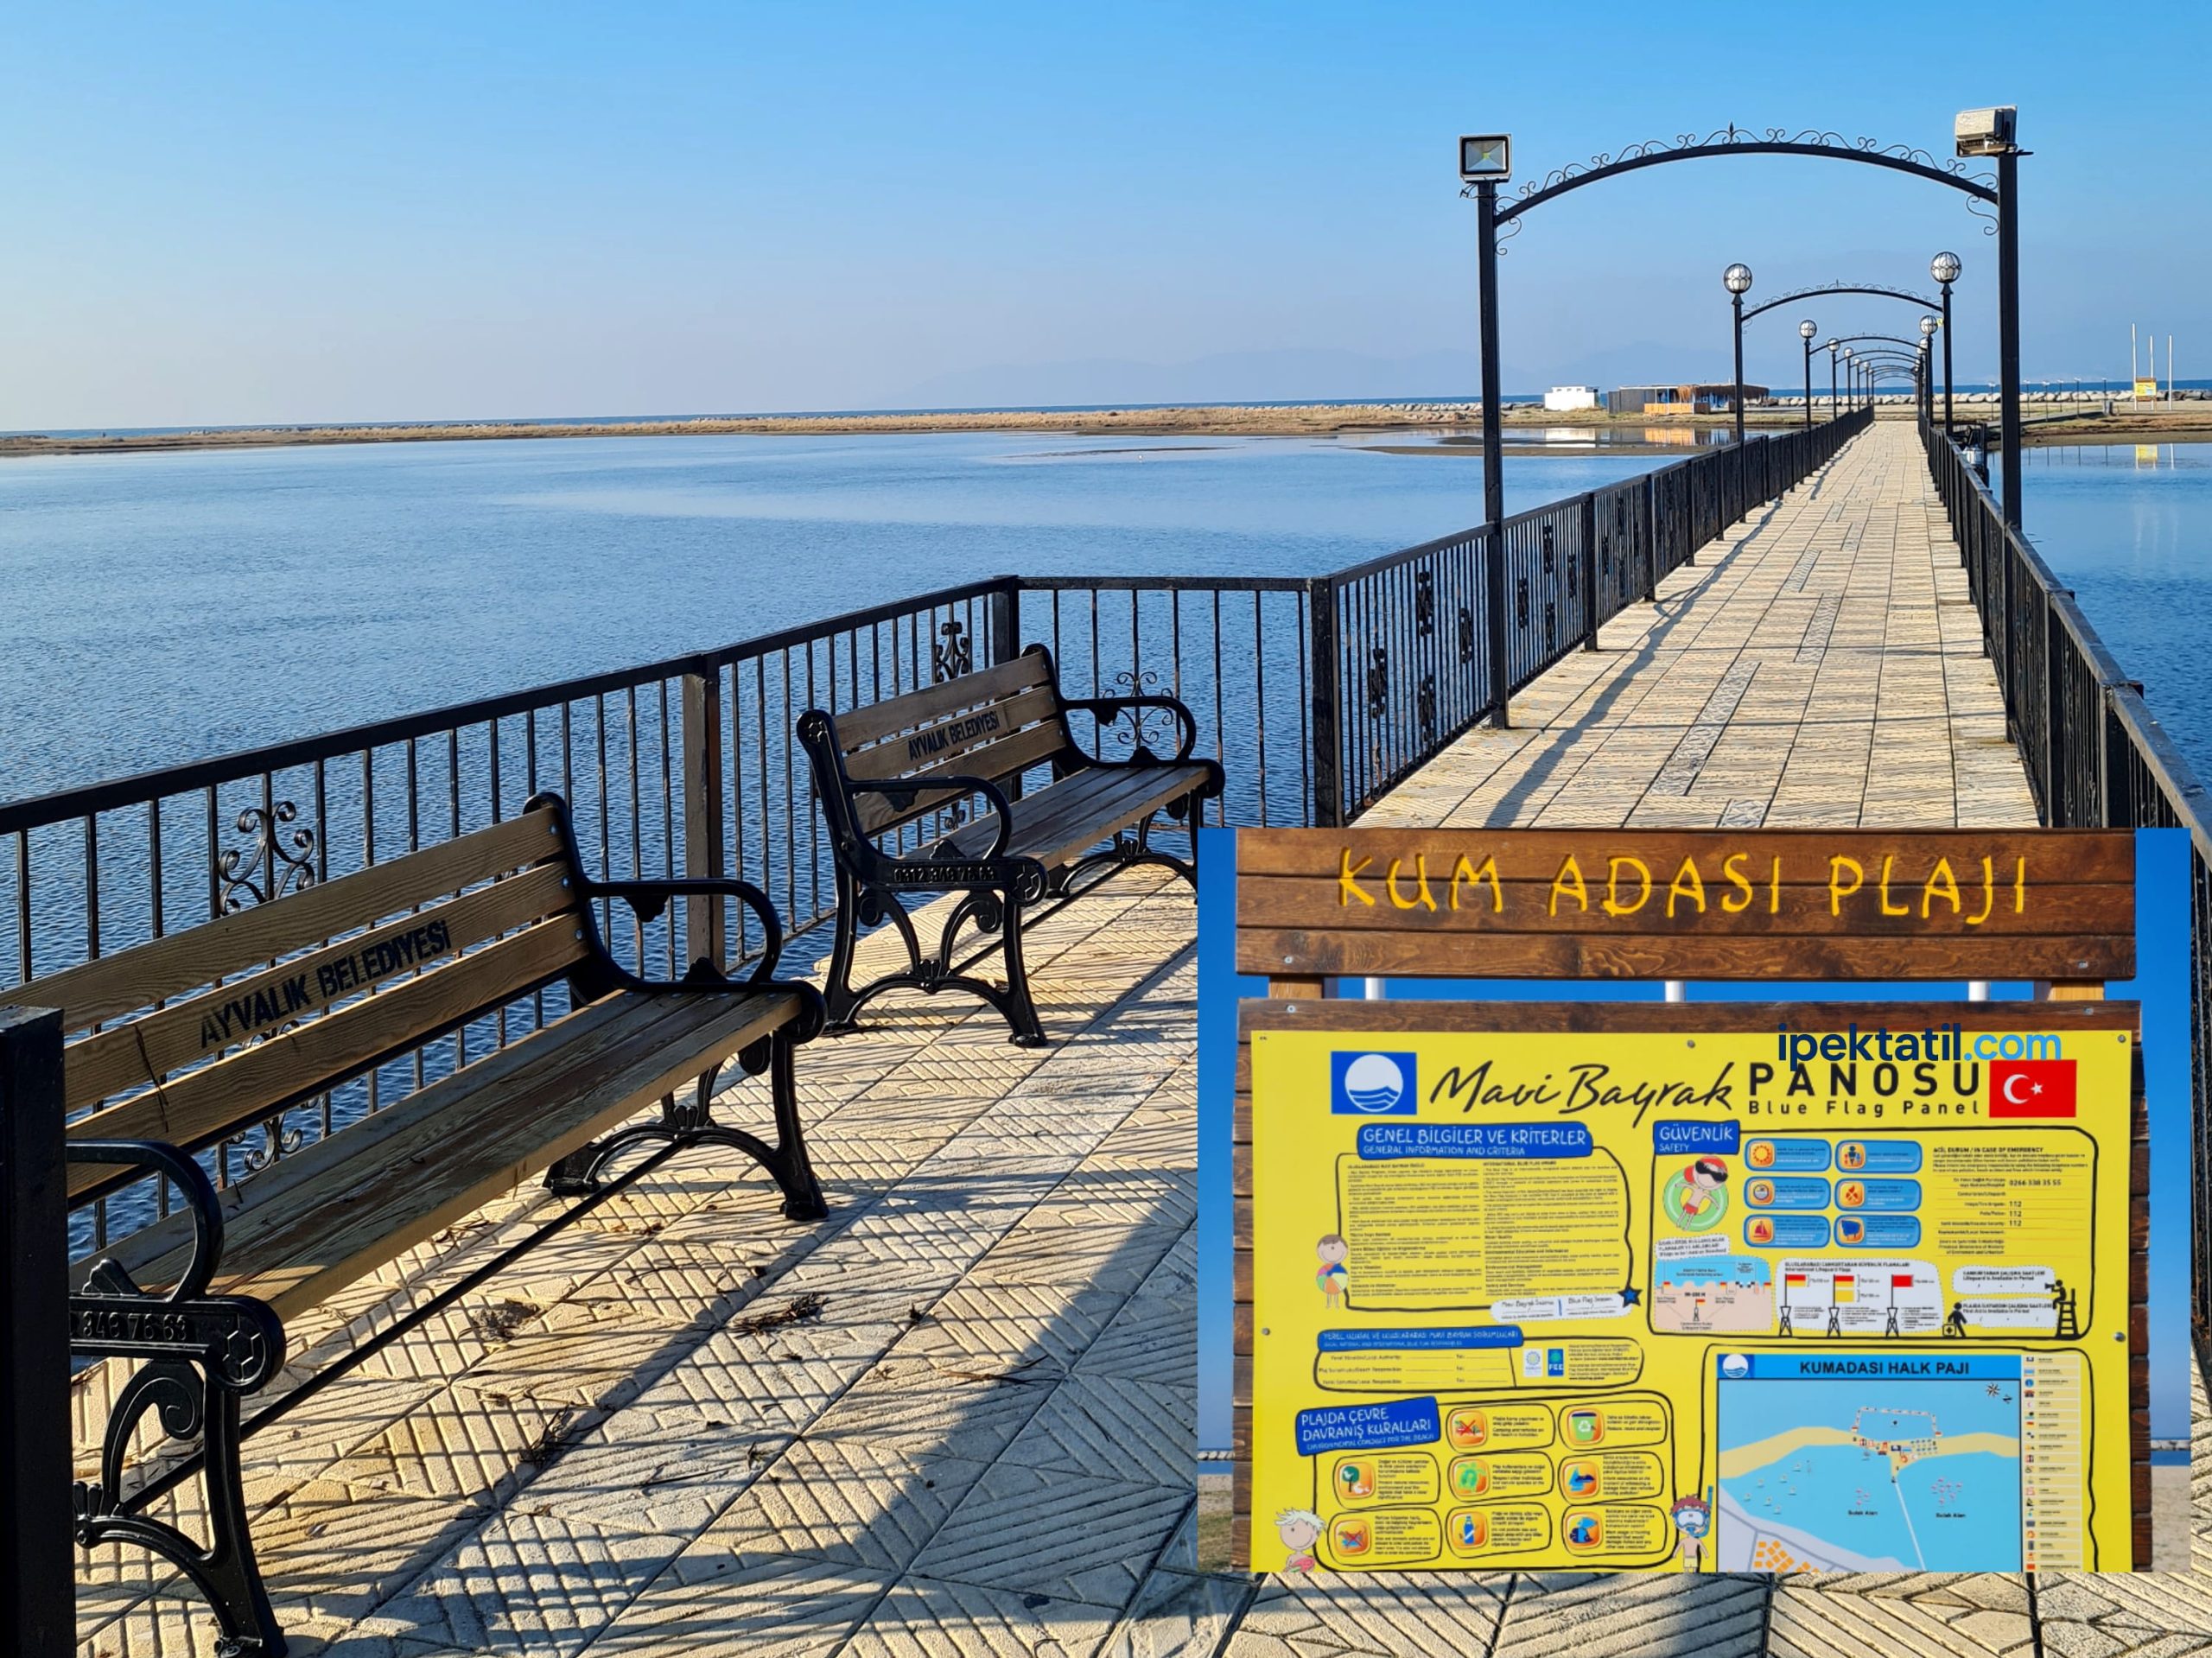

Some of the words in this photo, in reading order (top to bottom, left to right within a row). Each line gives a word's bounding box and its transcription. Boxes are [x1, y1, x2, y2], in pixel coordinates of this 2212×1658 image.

[908, 727, 949, 760] AYVALIK
[1339, 848, 1503, 913] KUM
[1550, 854, 1780, 918] ADASI
[1828, 854, 2026, 924] PLAJI
[200, 974, 311, 1048] AYVALIK
[1430, 1062, 1562, 1113] Mavi
[1559, 1062, 1734, 1128] Bayrak
[1749, 1063, 1980, 1097] PANOSU
[1749, 1100, 1808, 1115] Blue
[1827, 1100, 1885, 1119] Flag
[1904, 1100, 1980, 1115] Panel
[1363, 1128, 1413, 1143] GENEL
[1417, 1128, 1483, 1145] BİLGİLER
[1487, 1128, 1507, 1144] VE
[1511, 1128, 1586, 1145] KRİTERLER
[1659, 1124, 1733, 1141] GÜVENLİK
[1363, 1146, 1404, 1156] GENERAL
[1405, 1146, 1464, 1156] INFORMATION
[1466, 1146, 1485, 1156] AND
[1486, 1146, 1525, 1156] CRITERIA
[1659, 1143, 1690, 1153] SAFETY
[128, 1312, 155, 1340] 76
[1800, 1362, 1884, 1374] KUMADASI
[1888, 1362, 1931, 1374] HALK
[1936, 1363, 1969, 1375] PAJI
[1301, 1412, 1345, 1426] PLAJDA
[1349, 1407, 1389, 1425] ÇEVRE
[1303, 1425, 1363, 1441] DAVRANIŞ
[1367, 1420, 1431, 1435] KURALLARI
